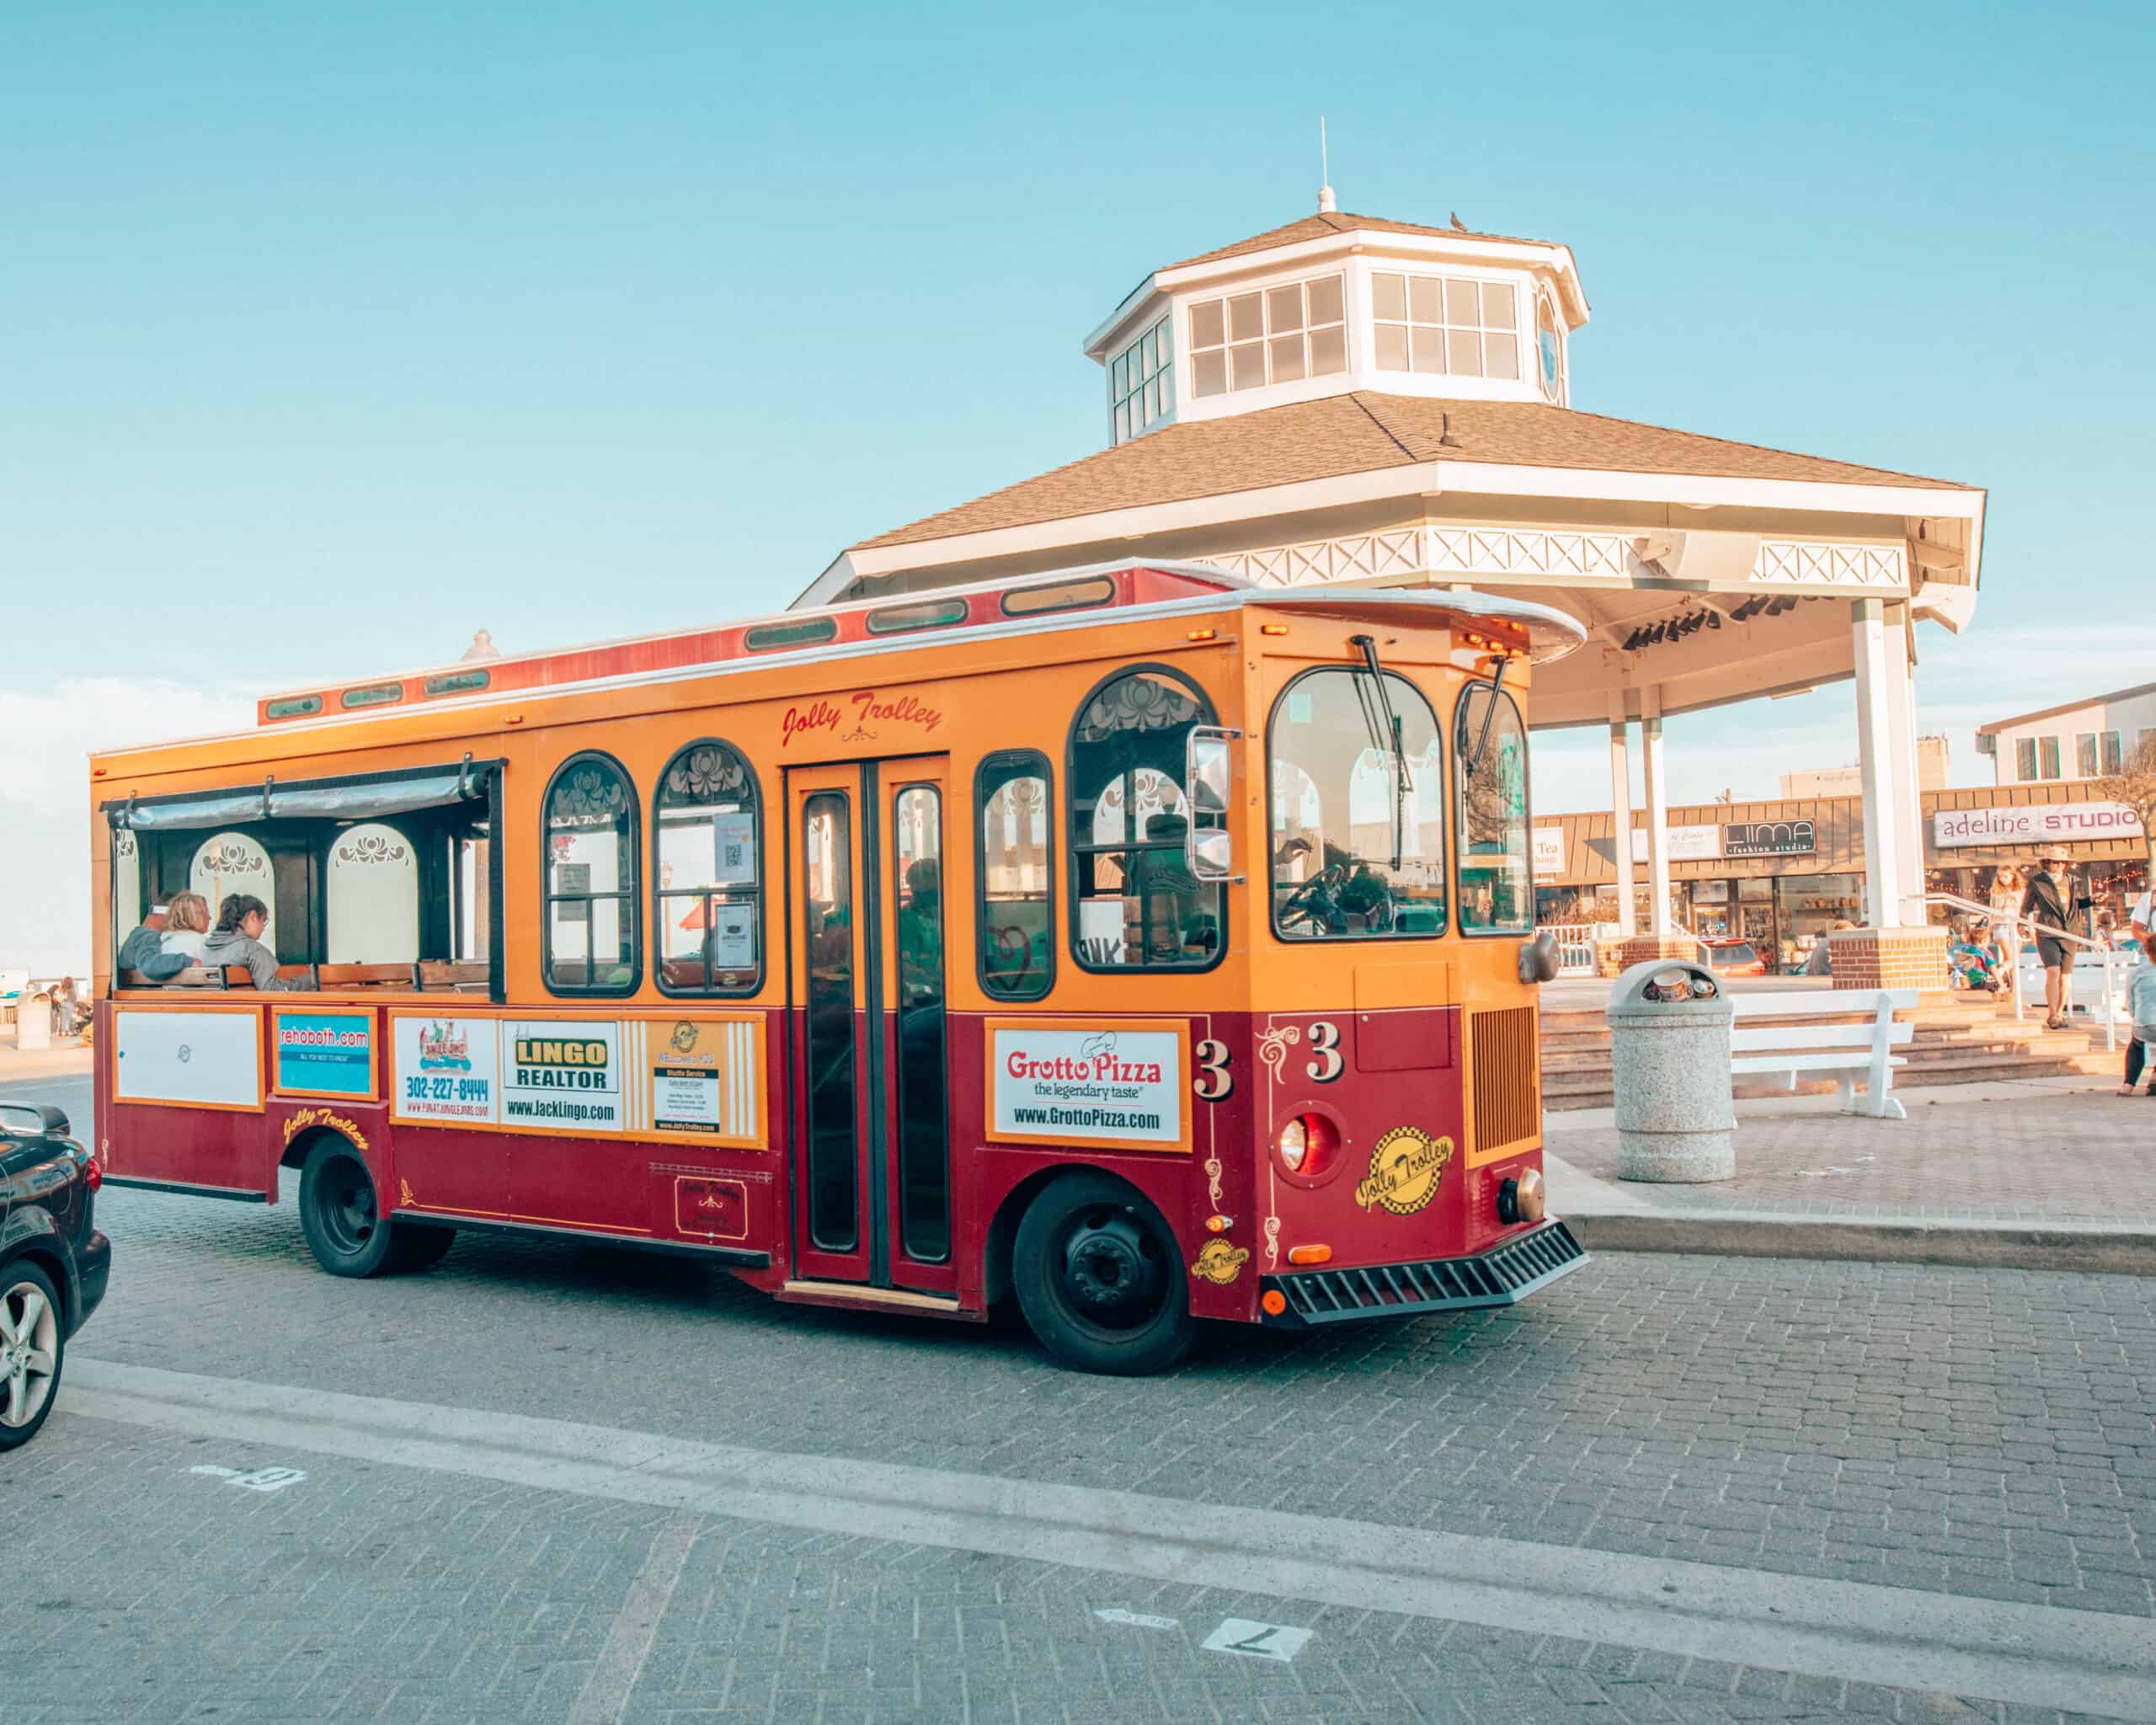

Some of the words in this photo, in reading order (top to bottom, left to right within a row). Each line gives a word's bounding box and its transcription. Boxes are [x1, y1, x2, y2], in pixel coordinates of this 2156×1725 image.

[782, 701, 841, 747] Jolly
[851, 692, 942, 733] Trolley
[1943, 810, 2029, 837] adeline
[2046, 810, 2137, 829] STUDIO
[1732, 845, 1769, 853] fashion
[1775, 842, 1807, 851] studio
[280, 1026, 368, 1048] rehoboth.com
[516, 1042, 607, 1065] LINGO
[1306, 1022, 1344, 1083] 3
[517, 1069, 606, 1089] REALTOR
[1007, 1051, 1089, 1080] Grotto
[1093, 1053, 1161, 1083] Pizza
[1193, 1039, 1233, 1102] 3
[406, 1076, 488, 1102] 302-227-8444
[1034, 1082, 1052, 1096] the
[1054, 1083, 1109, 1100] legendary
[507, 1099, 614, 1122] www.JackLingo.com
[1014, 1106, 1160, 1130] www.GrottoPizza.com
[284, 1108, 315, 1146] Jolly
[317, 1108, 370, 1151] Trolley
[1359, 1167, 1398, 1213] Jolly
[1395, 1140, 1450, 1179] Trolley
